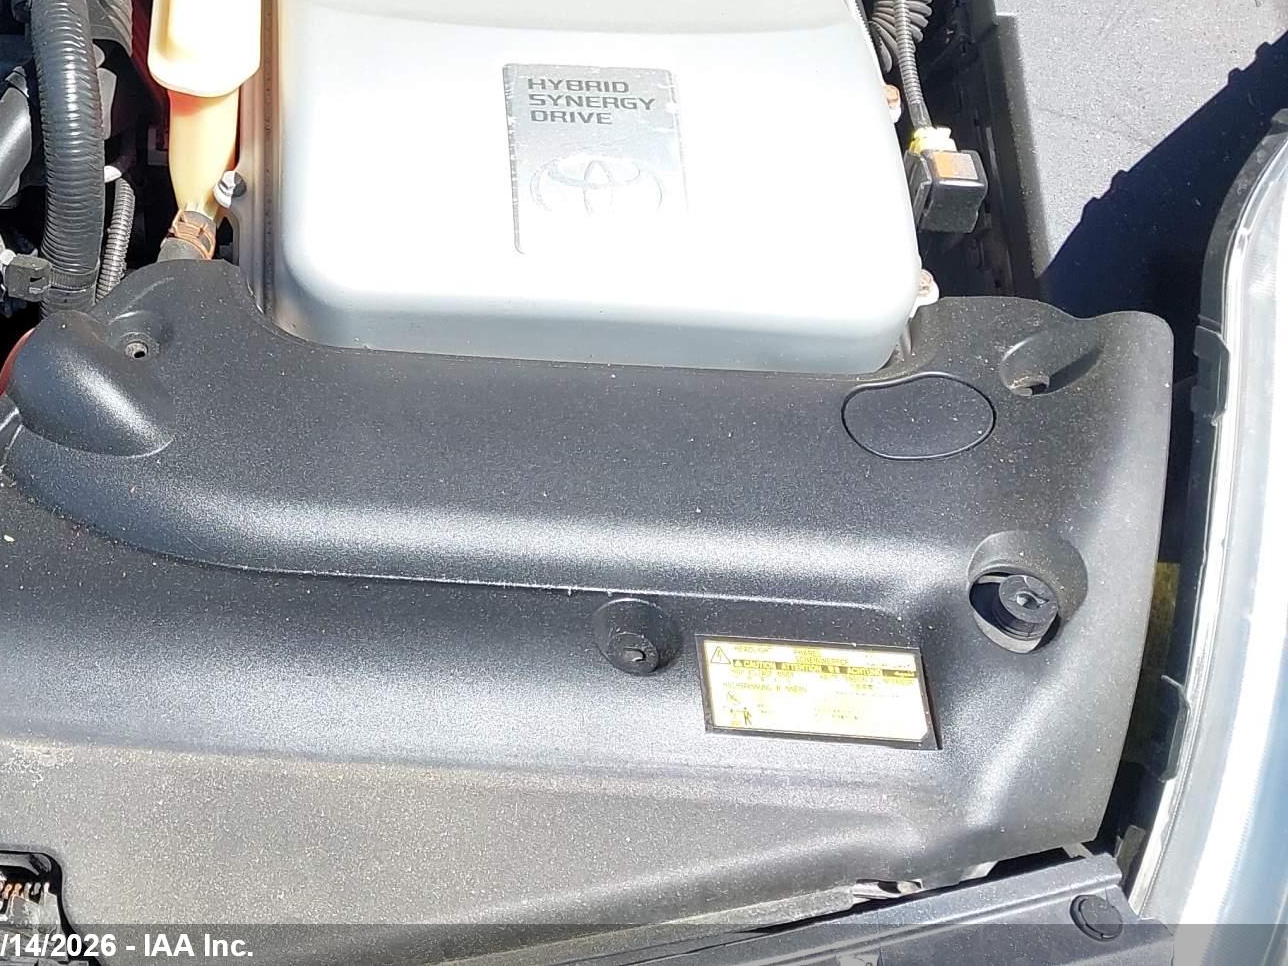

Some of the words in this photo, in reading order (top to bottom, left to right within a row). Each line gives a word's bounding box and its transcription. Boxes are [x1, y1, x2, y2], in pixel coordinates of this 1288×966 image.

[527, 78, 630, 93] HYBRID
[528, 94, 656, 110] SYNERGY
[530, 110, 613, 124] DRIVE
[743, 660, 777, 669] CAUTION
[781, 663, 822, 673] ATTENTION
[847, 667, 883, 676] ACHTUNG
